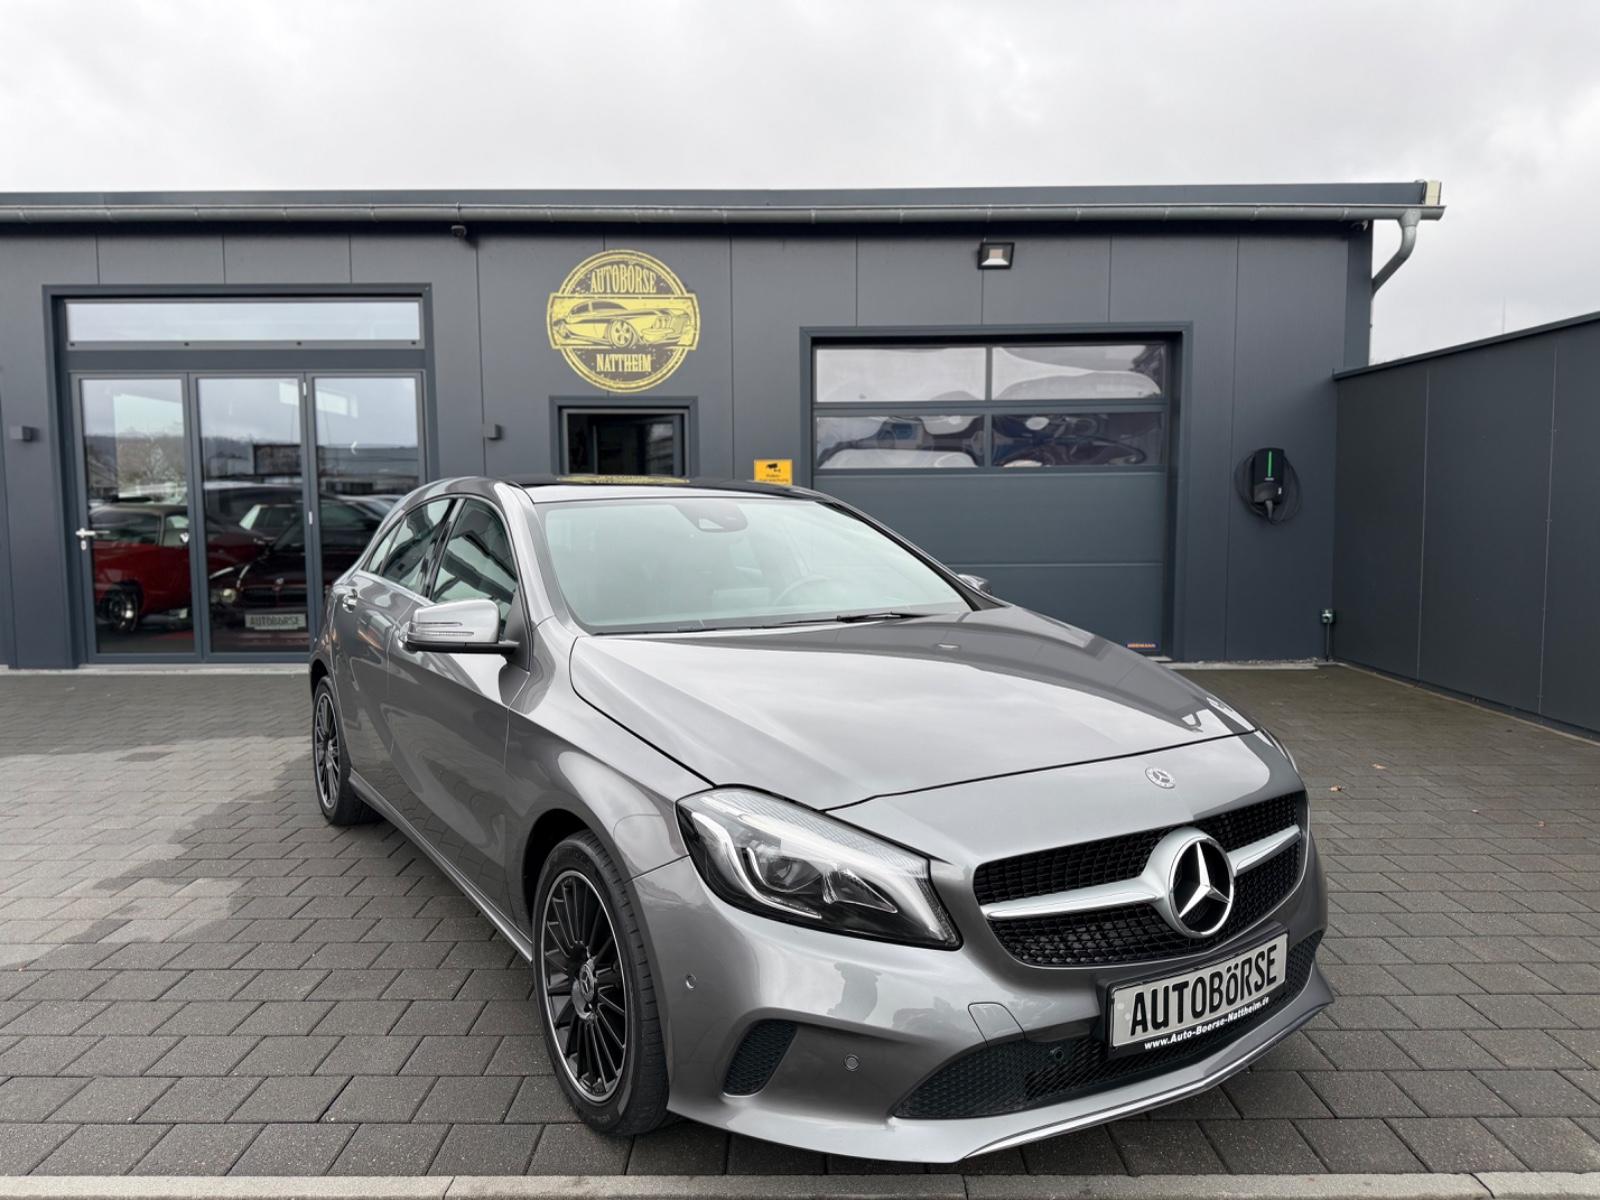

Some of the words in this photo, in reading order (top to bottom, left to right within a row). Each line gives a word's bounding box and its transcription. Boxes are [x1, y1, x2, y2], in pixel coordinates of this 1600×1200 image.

[596, 353, 652, 372] NATTHEIM
[1130, 944, 1277, 1036] AUTOBÖRSE
[1144, 996, 1270, 1050] www.Auto-Boerse-Nattheim.de
